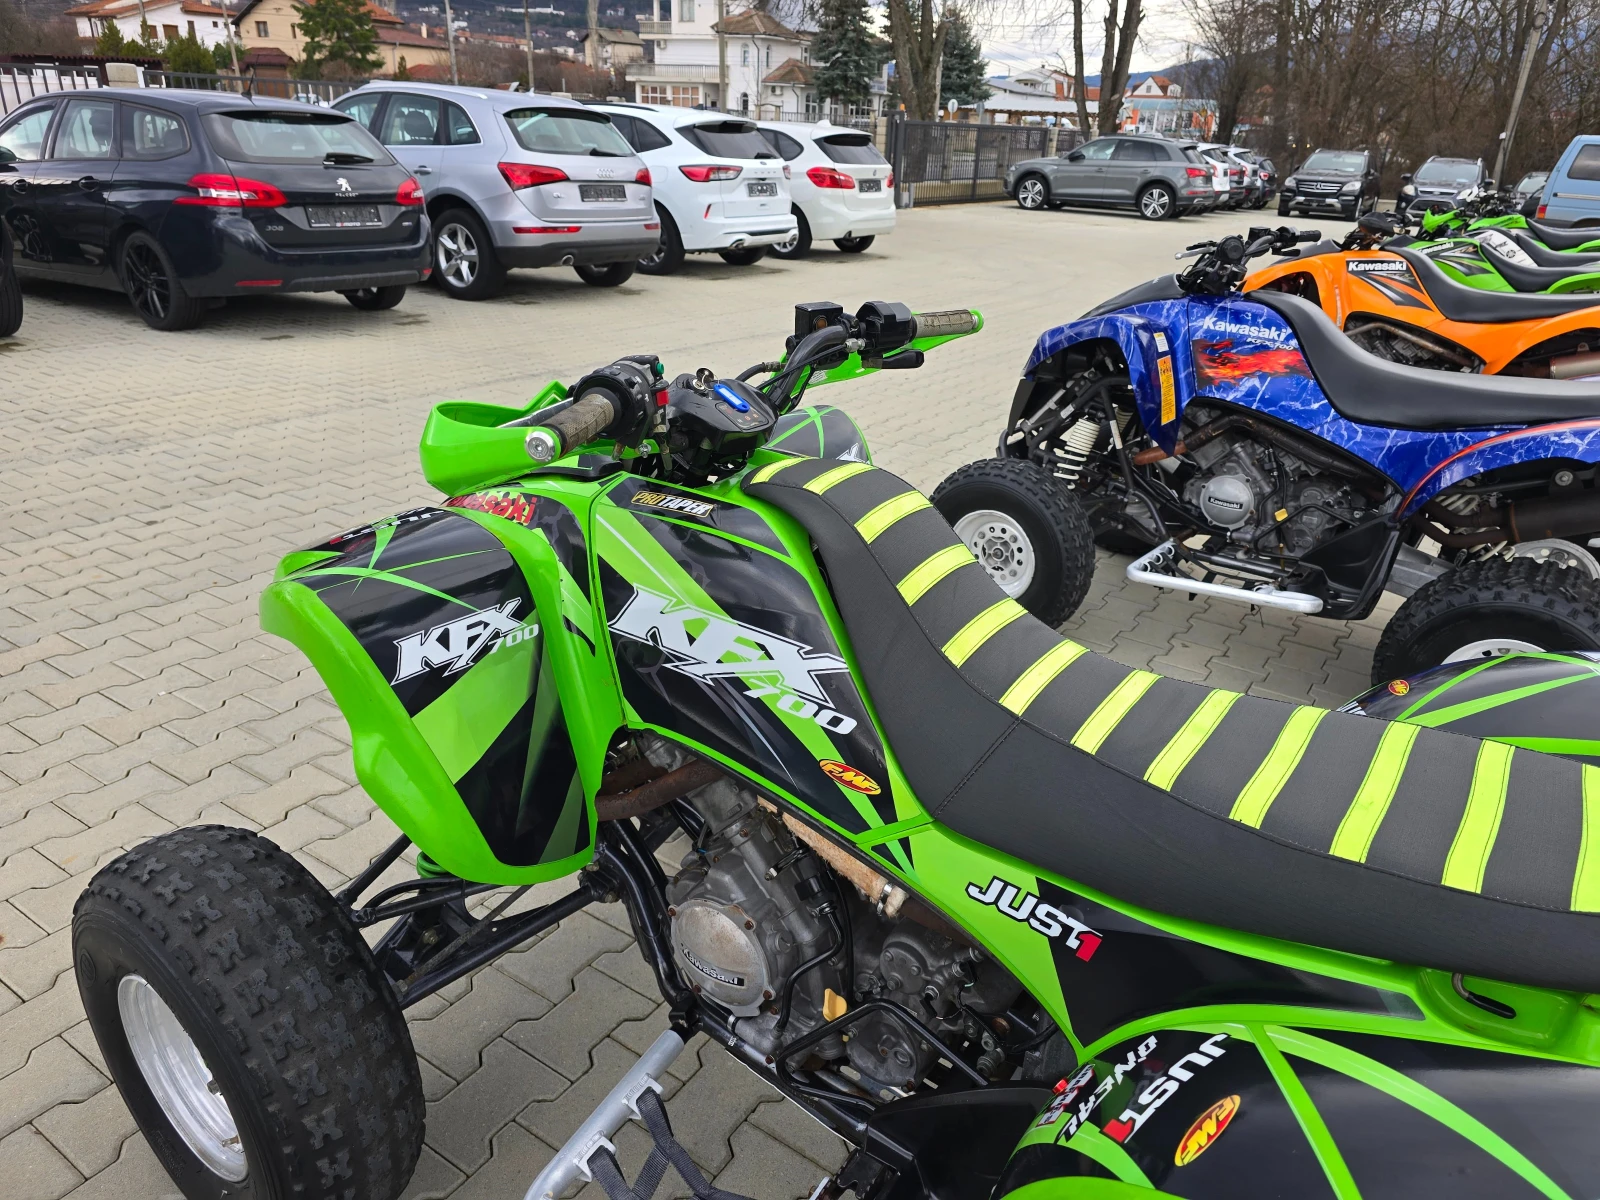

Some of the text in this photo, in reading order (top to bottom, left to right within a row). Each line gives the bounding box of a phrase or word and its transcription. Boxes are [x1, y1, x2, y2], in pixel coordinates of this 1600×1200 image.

[1348, 261, 1407, 271] Kawasaki
[1203, 316, 1287, 342] Kawasaki
[391, 597, 540, 686] KFX 700
[607, 584, 858, 735] KFX 700
[820, 760, 880, 794] FMF
[965, 876, 1104, 963] JUST1
[683, 948, 739, 985] Kawasaki
[1102, 1033, 1229, 1144] JUST1
[1176, 1095, 1240, 1166] FMF
